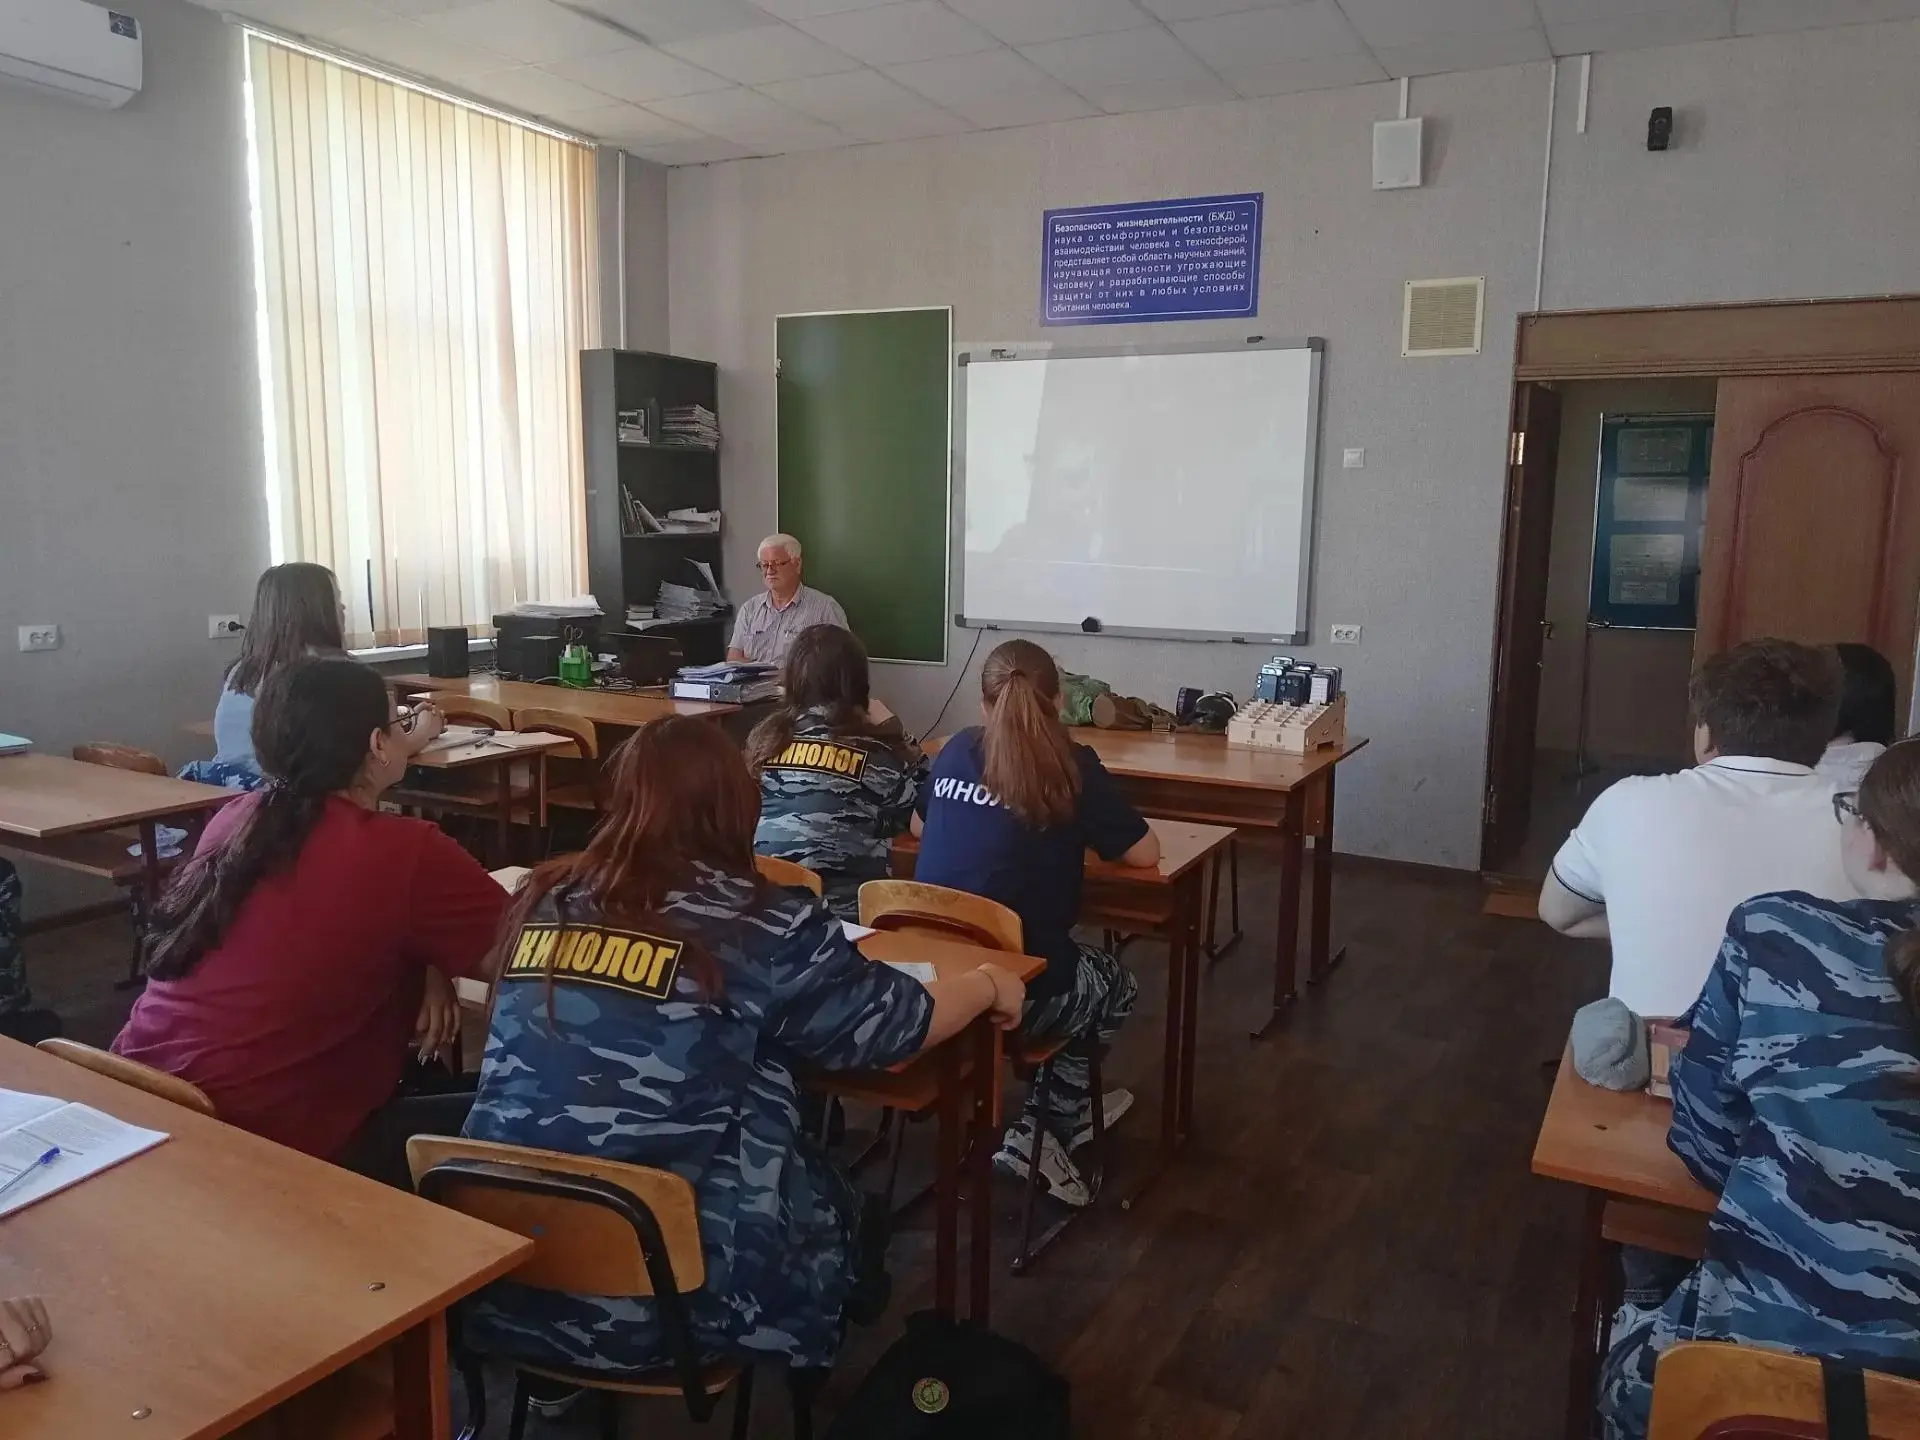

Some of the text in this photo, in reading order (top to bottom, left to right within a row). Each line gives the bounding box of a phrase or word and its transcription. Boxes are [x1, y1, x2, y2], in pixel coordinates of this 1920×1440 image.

[1055, 222, 1112, 233] Безопасность
[1116, 215, 1203, 228] жизнедеятельности
[1208, 210, 1236, 223] (БЖД)
[1054, 235, 1083, 245] наука
[1099, 229, 1166, 241] комфортном
[1171, 228, 1178, 236] и
[1183, 223, 1248, 235] безопасном
[1054, 244, 1125, 256] взаимодействии
[1129, 240, 1170, 250] человека
[1053, 259, 1246, 279] изучающая опасности угрожающие
[1054, 256, 1110, 268] представляет
[1111, 253, 1136, 263] собой
[1138, 252, 1172, 262] область
[1174, 250, 1211, 261] научных
[1053, 279, 1094, 290] человеку
[1109, 274, 1198, 287] разрабатывающие
[1203, 270, 1246, 281] способы
[1052, 292, 1092, 302] защиты
[1115, 289, 1134, 298] них
[1151, 286, 1187, 296] любых
[1193, 284, 1245, 296] условиях
[1052, 302, 1090, 312] обитания
[766, 742, 865, 775] ИНОЛОГ
[510, 930, 677, 989] КИНОЛОГ
